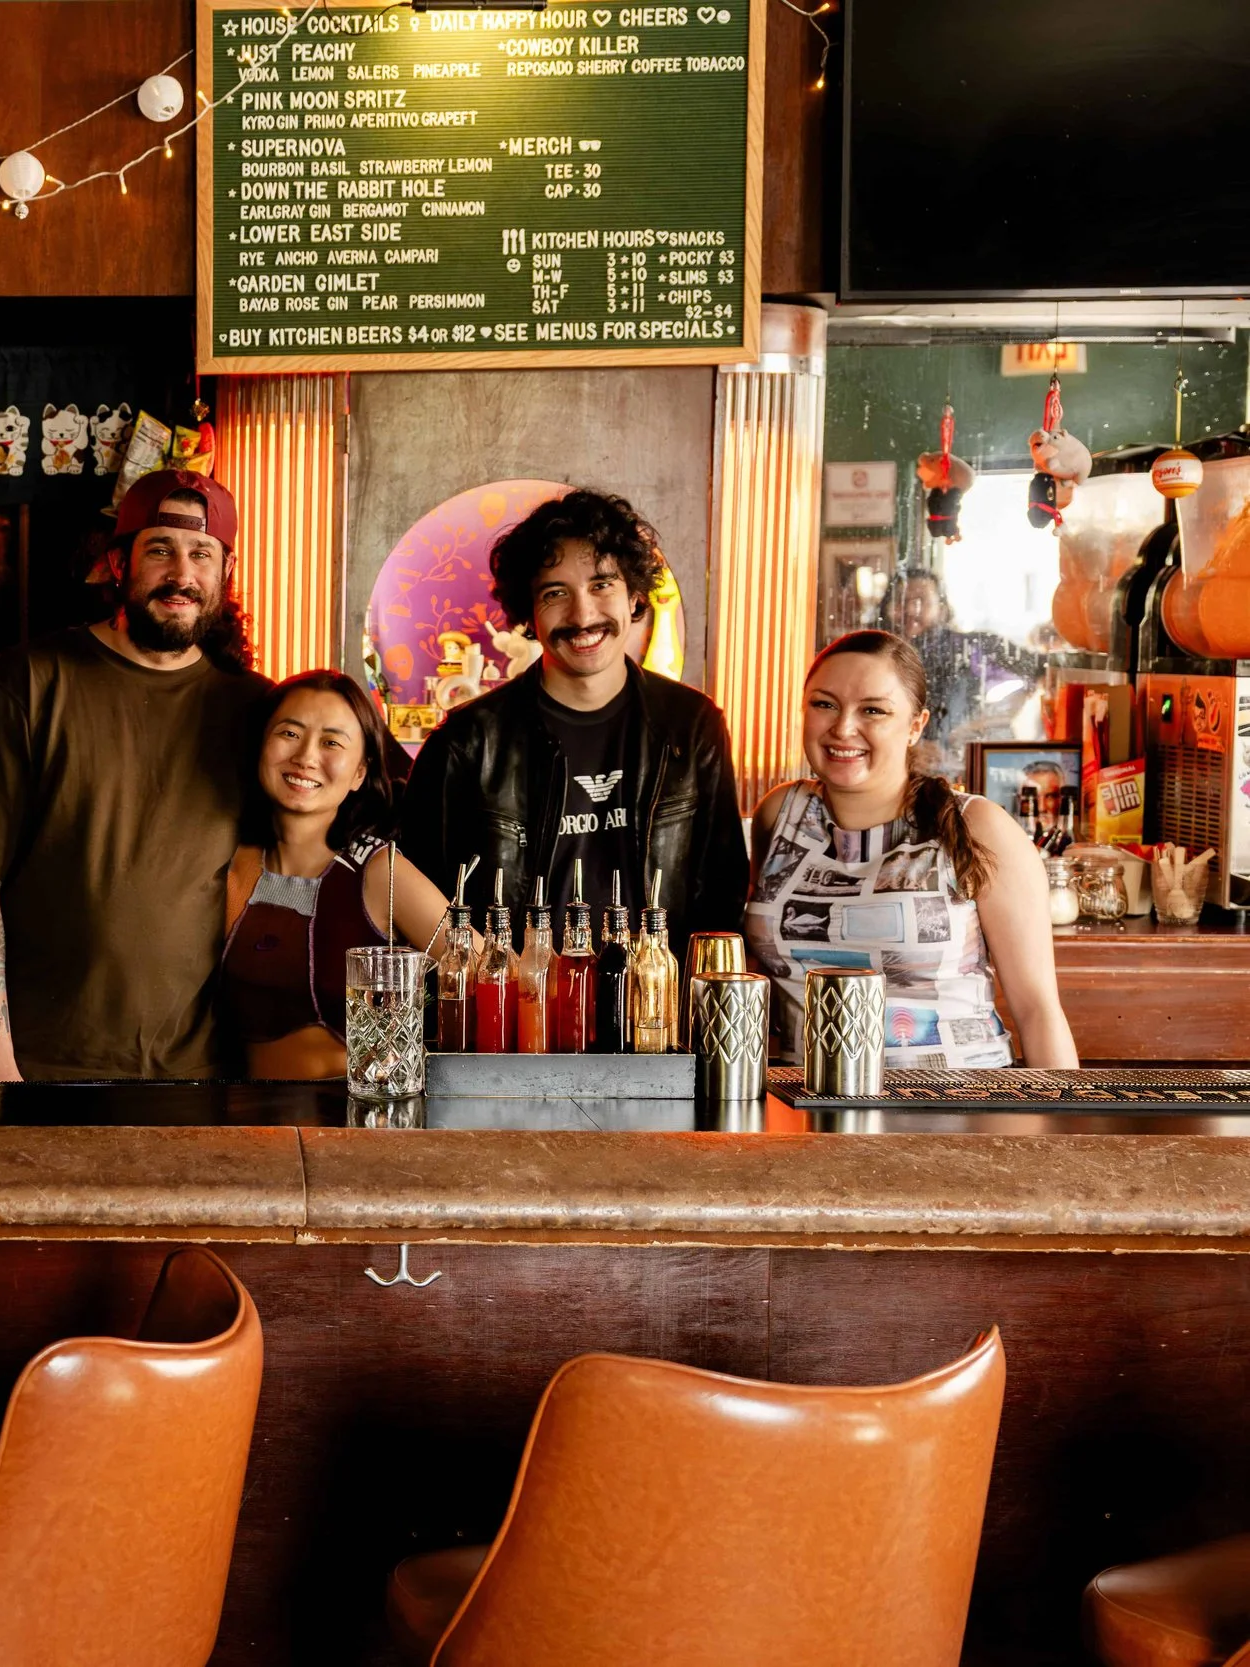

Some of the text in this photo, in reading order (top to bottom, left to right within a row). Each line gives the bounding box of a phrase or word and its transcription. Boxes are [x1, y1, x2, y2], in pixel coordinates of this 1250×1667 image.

[307, 7, 688, 34] COCKTAILS HOUR CHEERS
[292, 43, 356, 62] PEACHY
[506, 36, 639, 56] COWBOY KILLER
[292, 63, 481, 82] LEMON SALERS PINEAPPLE
[507, 56, 745, 76] REPOSADO SHERRY COFFEE TOBACCO
[242, 89, 406, 111] PINK MOON SPRITZ
[241, 138, 346, 157] SUPERNOVA
[509, 137, 572, 156] MERCH
[242, 158, 492, 177] BOURBON BASIL STRAWBERRY LEMON
[241, 179, 446, 200] DOWN THE RABBIT HOLE
[343, 201, 485, 218] BERGAMOT CINNAMON
[240, 223, 401, 244] LOWER EAST SIDE
[532, 229, 655, 249] KITCHEN HOURS
[669, 231, 725, 246] SNACKS
[240, 249, 438, 266] RYE ANCHO AVERNA CAMPARI
[669, 250, 714, 266] POCKY
[237, 273, 380, 293] GARDEN GIMLET
[669, 270, 708, 285] SLIMS
[286, 294, 485, 311] ROSE PEAR PERSIMMON
[668, 289, 712, 304] CHIPS
[229, 326, 402, 347] BUY KITCHEN BEERS
[494, 320, 723, 341] SEE MENUS FOR SPECIALS
